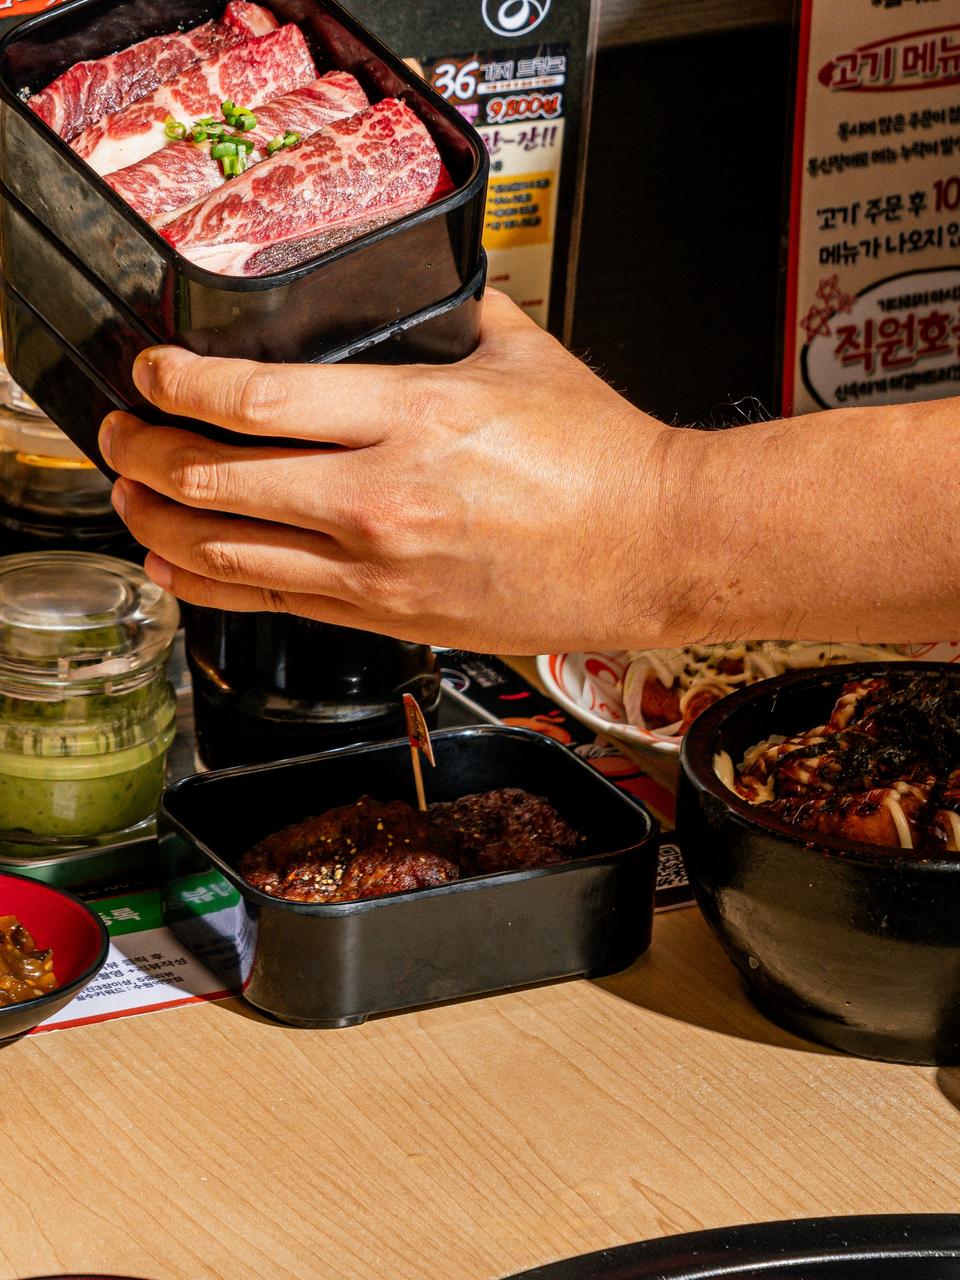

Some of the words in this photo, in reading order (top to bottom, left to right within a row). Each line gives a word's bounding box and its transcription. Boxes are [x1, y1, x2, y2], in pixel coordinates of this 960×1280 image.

[435, 61, 480, 100] 36
[818, 236, 882, 266] 메뉴가
[884, 221, 944, 255] 나오지
[833, 310, 960, 375] 직원호
